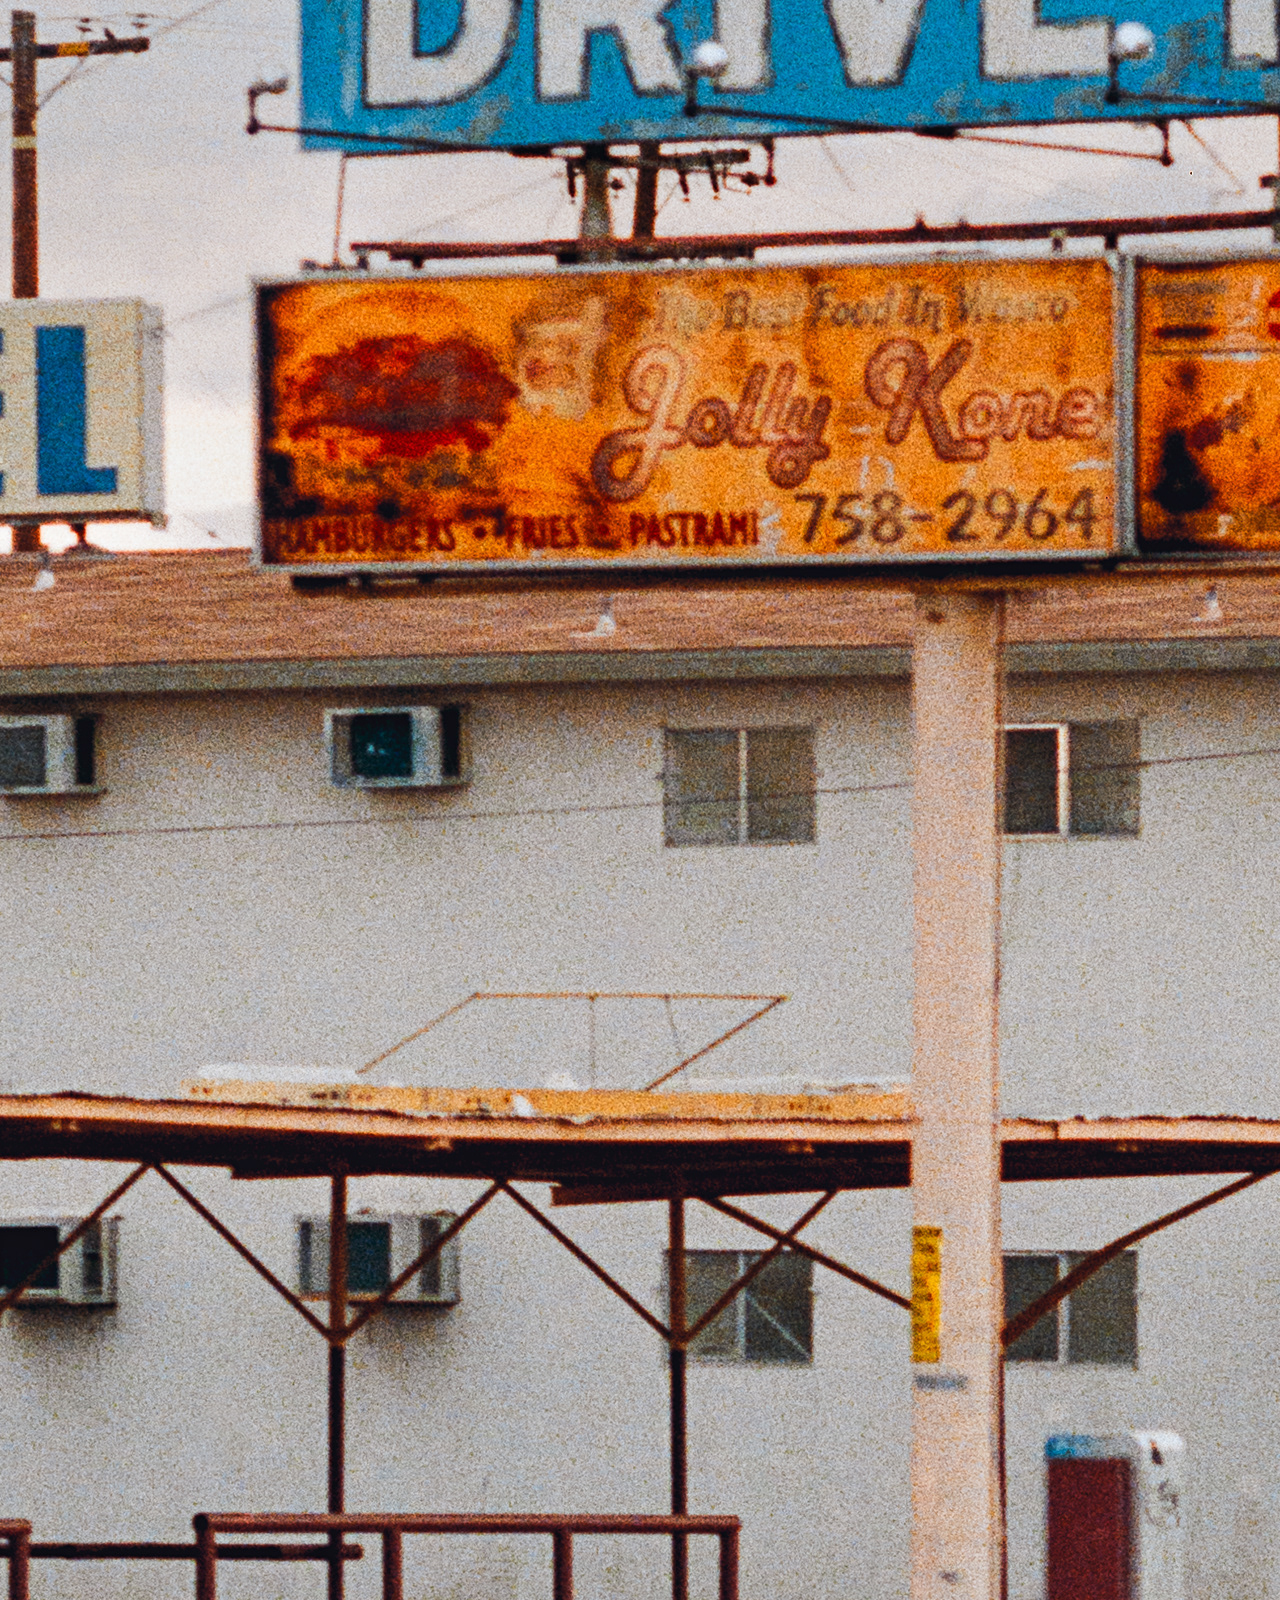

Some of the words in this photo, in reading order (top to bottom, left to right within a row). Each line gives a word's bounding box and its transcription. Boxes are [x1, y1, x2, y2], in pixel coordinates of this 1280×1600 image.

[590, 343, 833, 502] Jolly
[863, 338, 1102, 463] Kone
[505, 513, 580, 549] FRIES
[628, 510, 760, 548] PASTRAMI
[794, 486, 1100, 546] 758-2964
